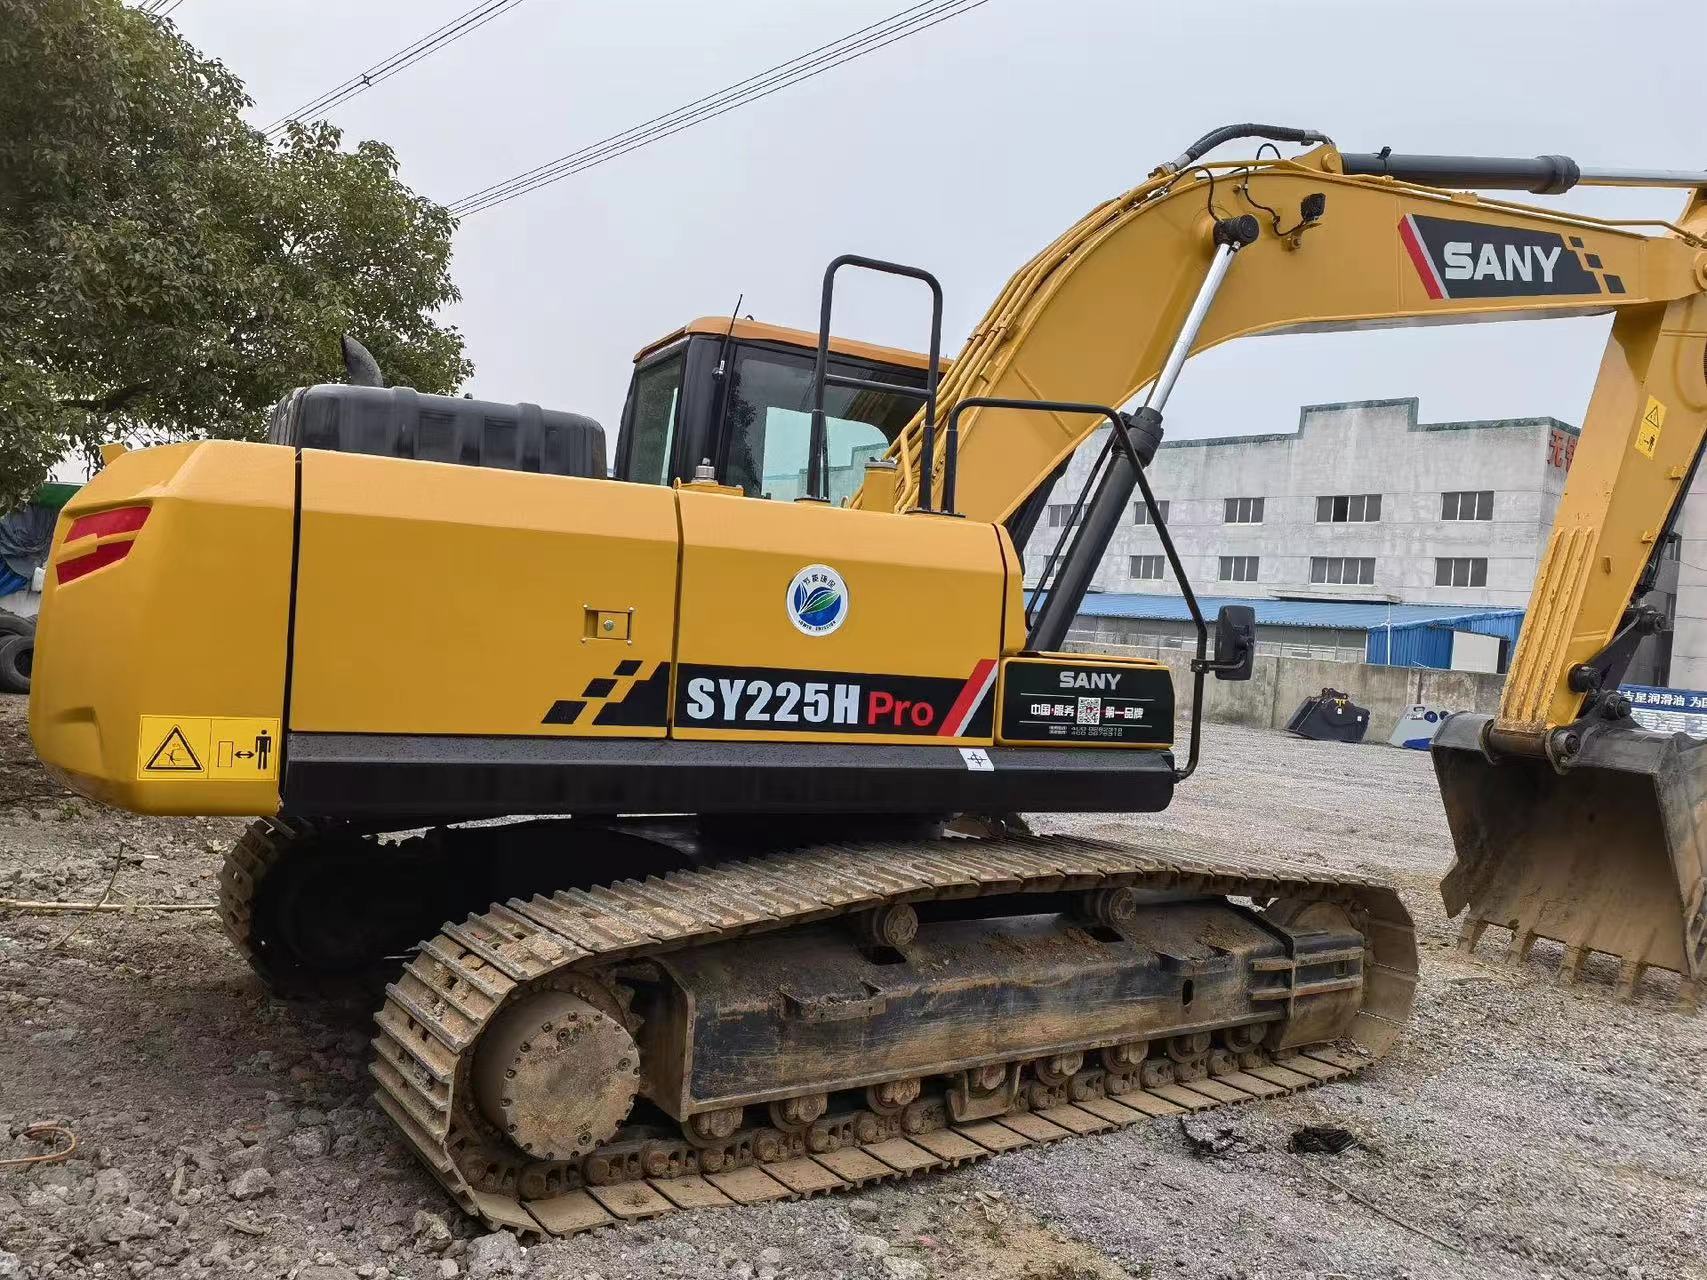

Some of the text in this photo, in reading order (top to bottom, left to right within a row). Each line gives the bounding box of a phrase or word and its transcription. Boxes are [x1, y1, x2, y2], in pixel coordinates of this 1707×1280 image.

[1443, 241, 1562, 282] SANY
[1059, 671, 1121, 690] SANY
[686, 677, 935, 728] SY225H Pro
[1616, 690, 1685, 706] 吉星润滑油
[1105, 706, 1144, 719] 第一品牌
